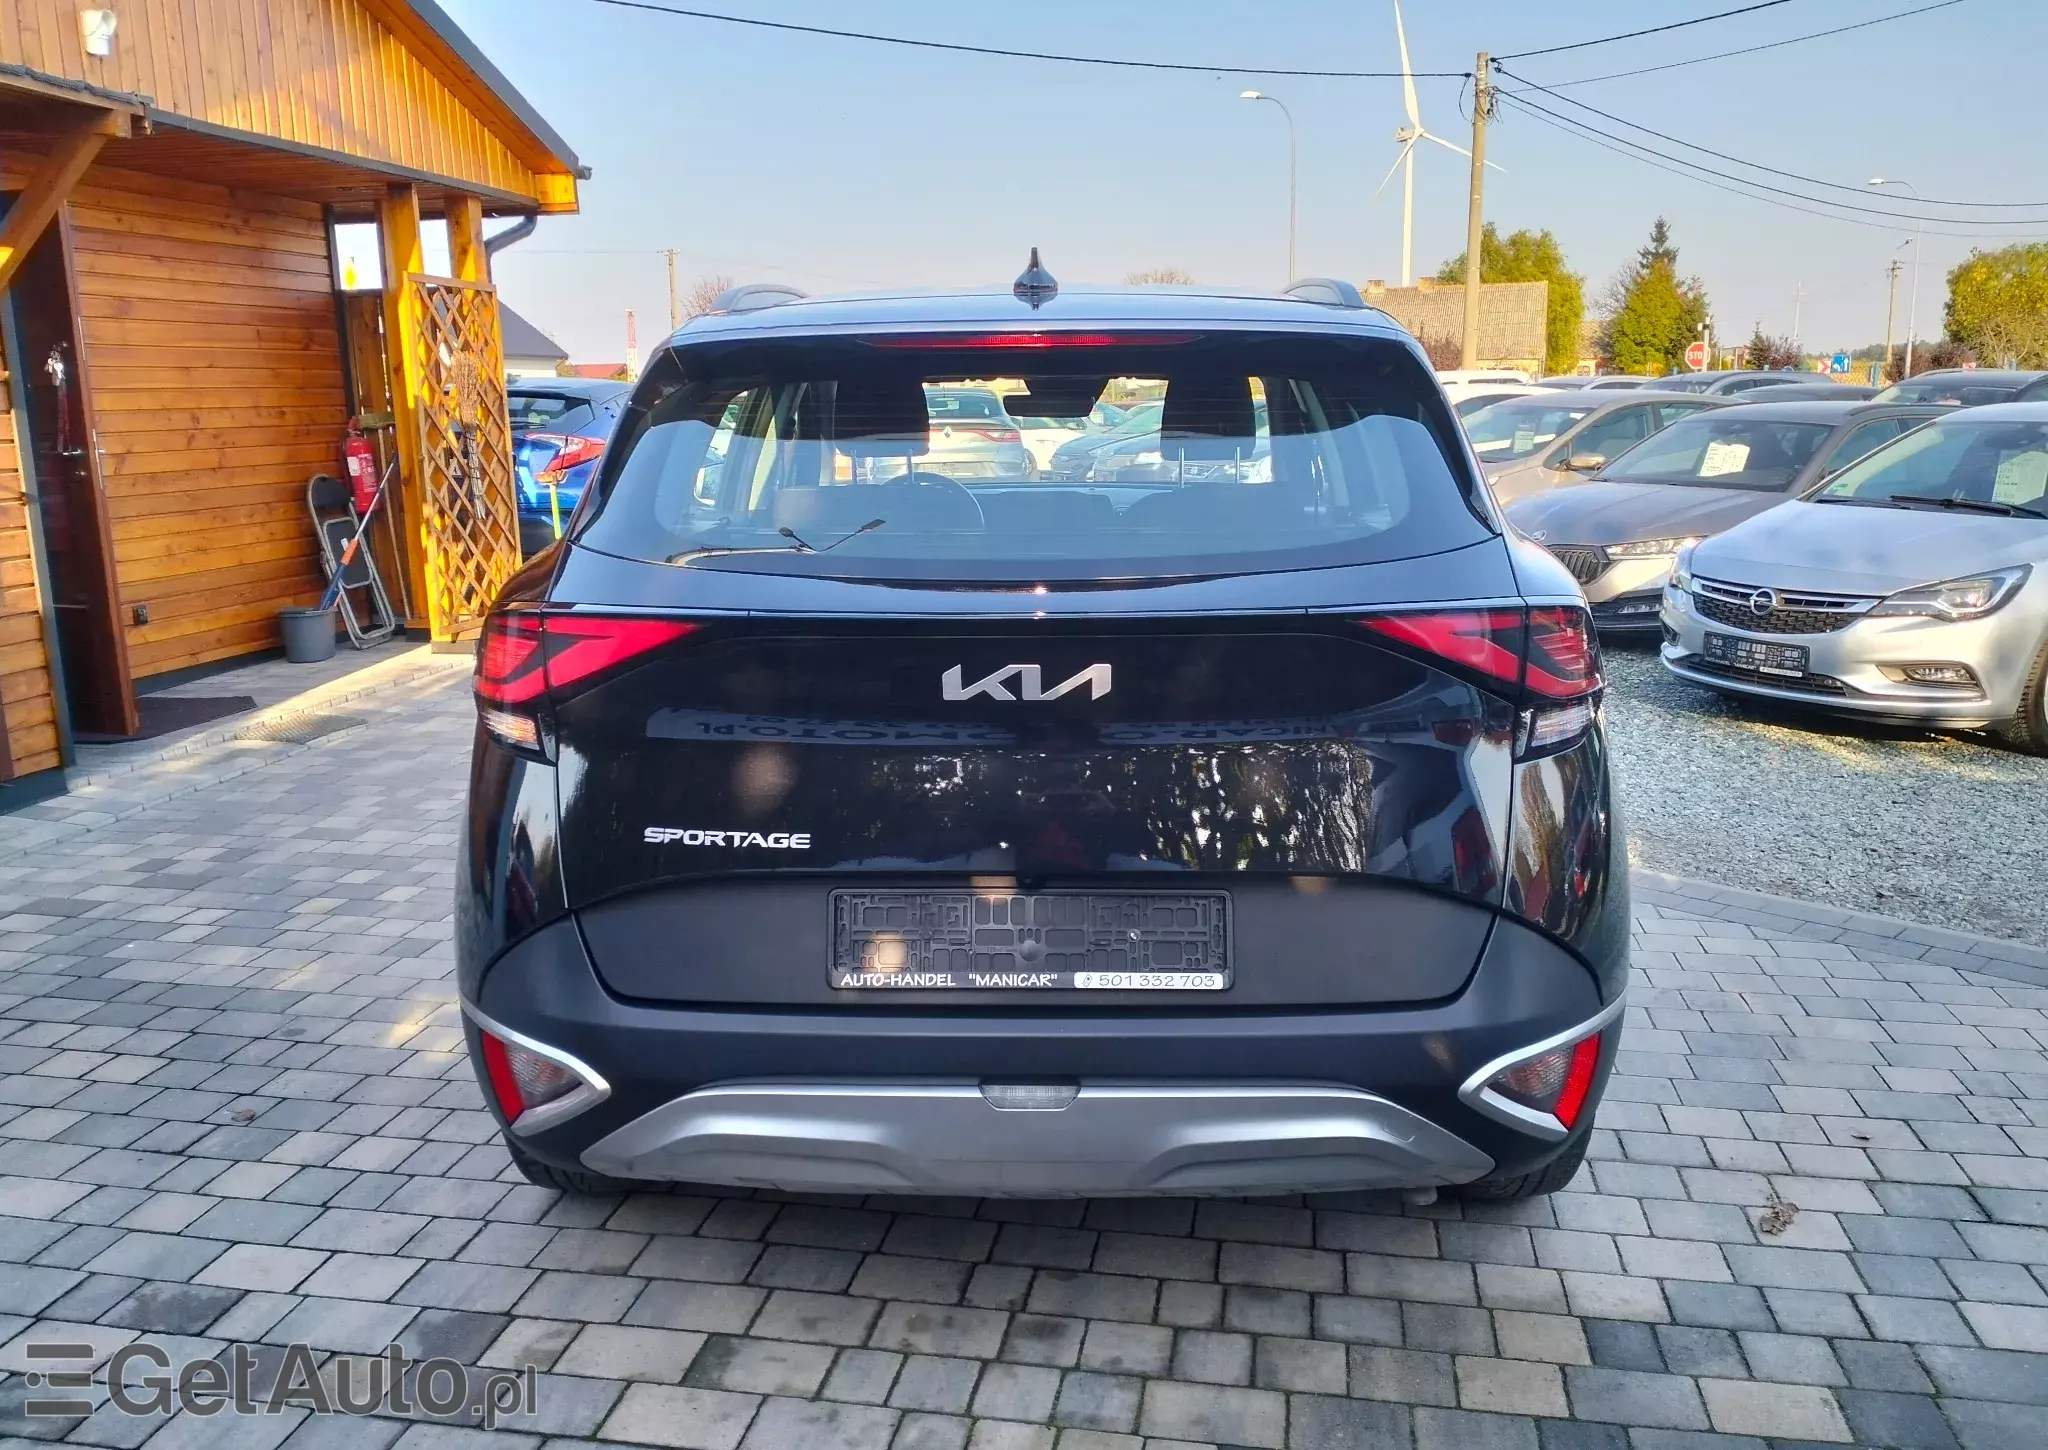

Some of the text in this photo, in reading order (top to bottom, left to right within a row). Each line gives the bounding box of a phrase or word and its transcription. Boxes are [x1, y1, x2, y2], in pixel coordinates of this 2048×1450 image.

[942, 663, 1112, 701] KIA
[643, 826, 812, 850] SPORTAGE
[840, 972, 1216, 988] AUTO-HANDEL "MANICAR" 501 332 703
